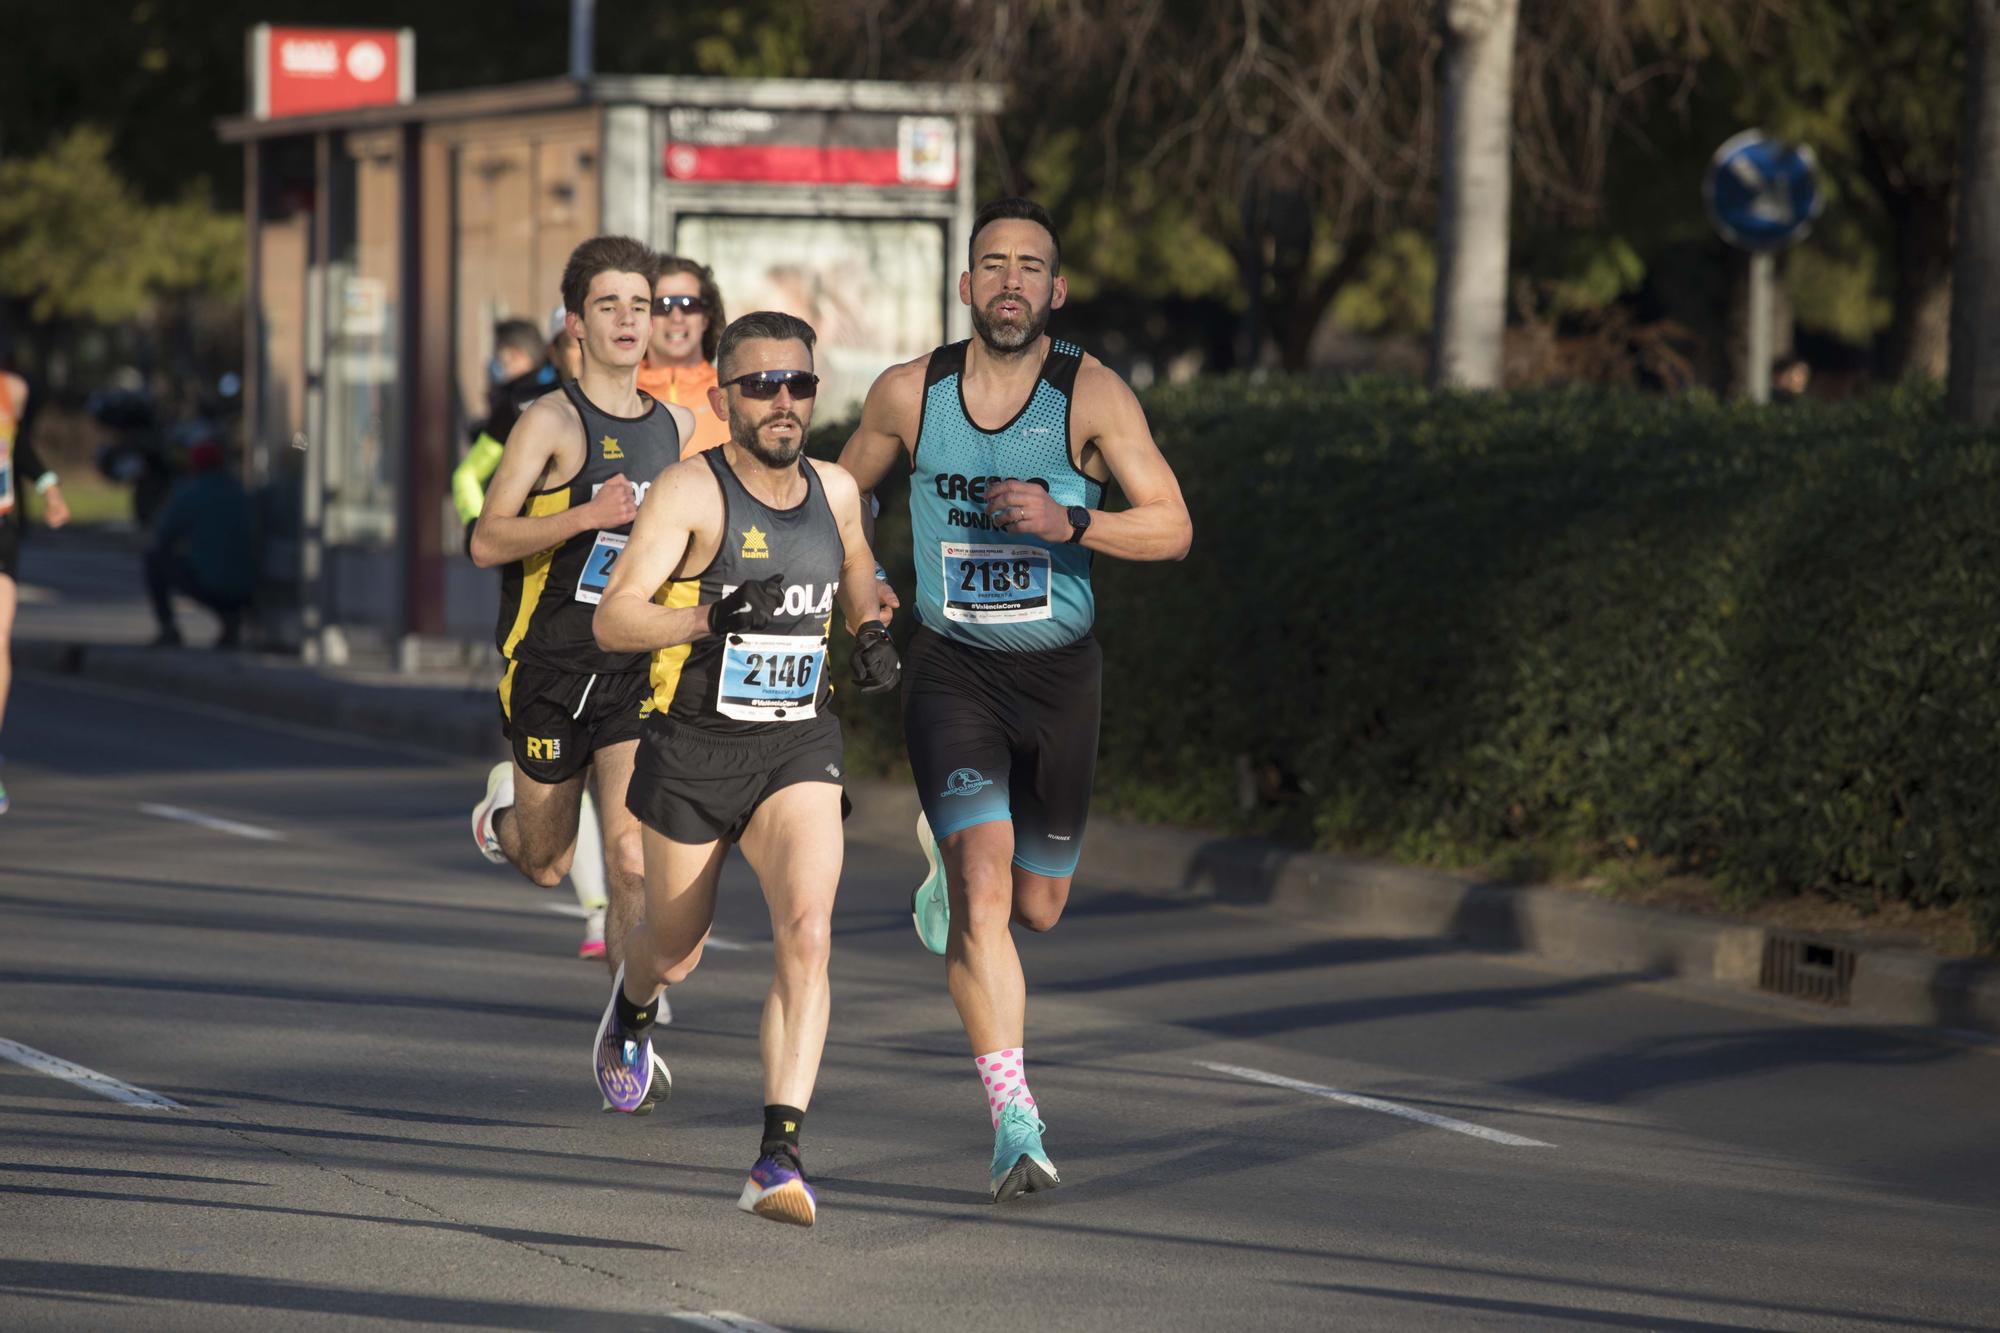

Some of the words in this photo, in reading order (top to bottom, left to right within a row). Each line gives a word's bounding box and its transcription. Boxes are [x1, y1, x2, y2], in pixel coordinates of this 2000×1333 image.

[742, 550, 768, 559] luanvi
[960, 559, 1030, 592] 2138
[743, 653, 814, 688] 2146
[553, 738, 561, 760] TEAM
